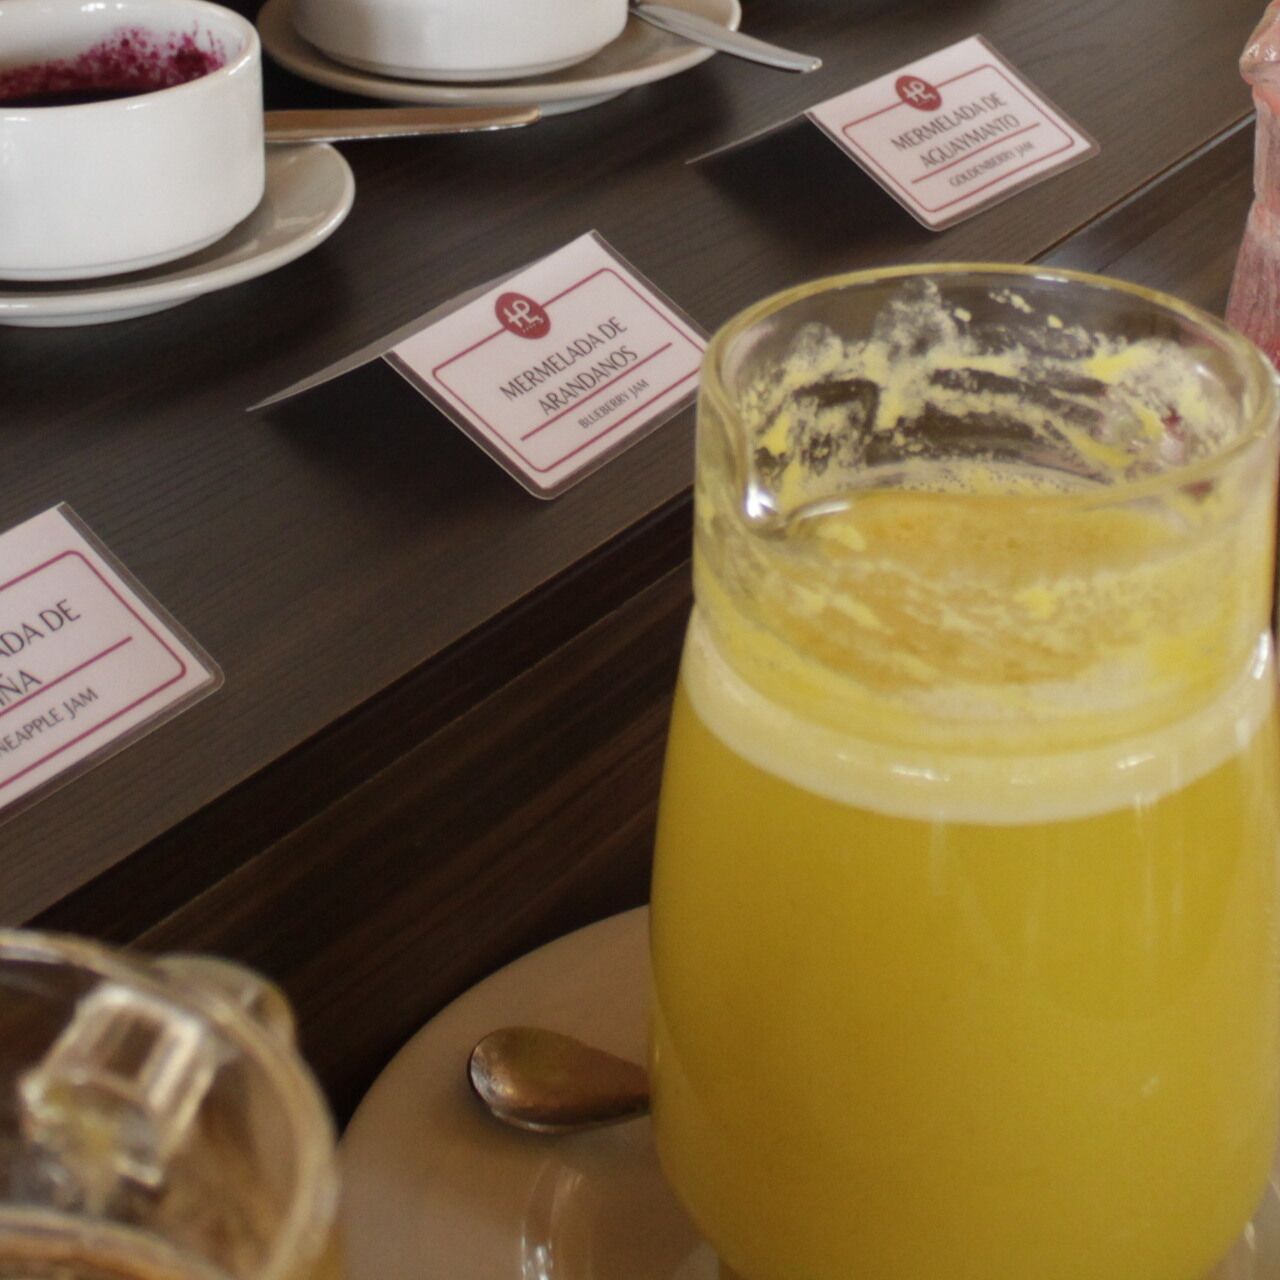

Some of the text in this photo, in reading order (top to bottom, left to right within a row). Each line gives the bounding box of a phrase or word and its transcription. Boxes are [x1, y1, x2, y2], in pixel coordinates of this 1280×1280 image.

[891, 92, 1005, 150] MERMELADA DE
[921, 114, 1018, 168] AGUAYMANTO
[499, 316, 627, 400] MERMELADA DE
[538, 345, 637, 415] ARANDANOS
[578, 378, 649, 428] BLUEBERRY JAM
[39, 599, 81, 631] DE
[62, 687, 98, 719] JAM
